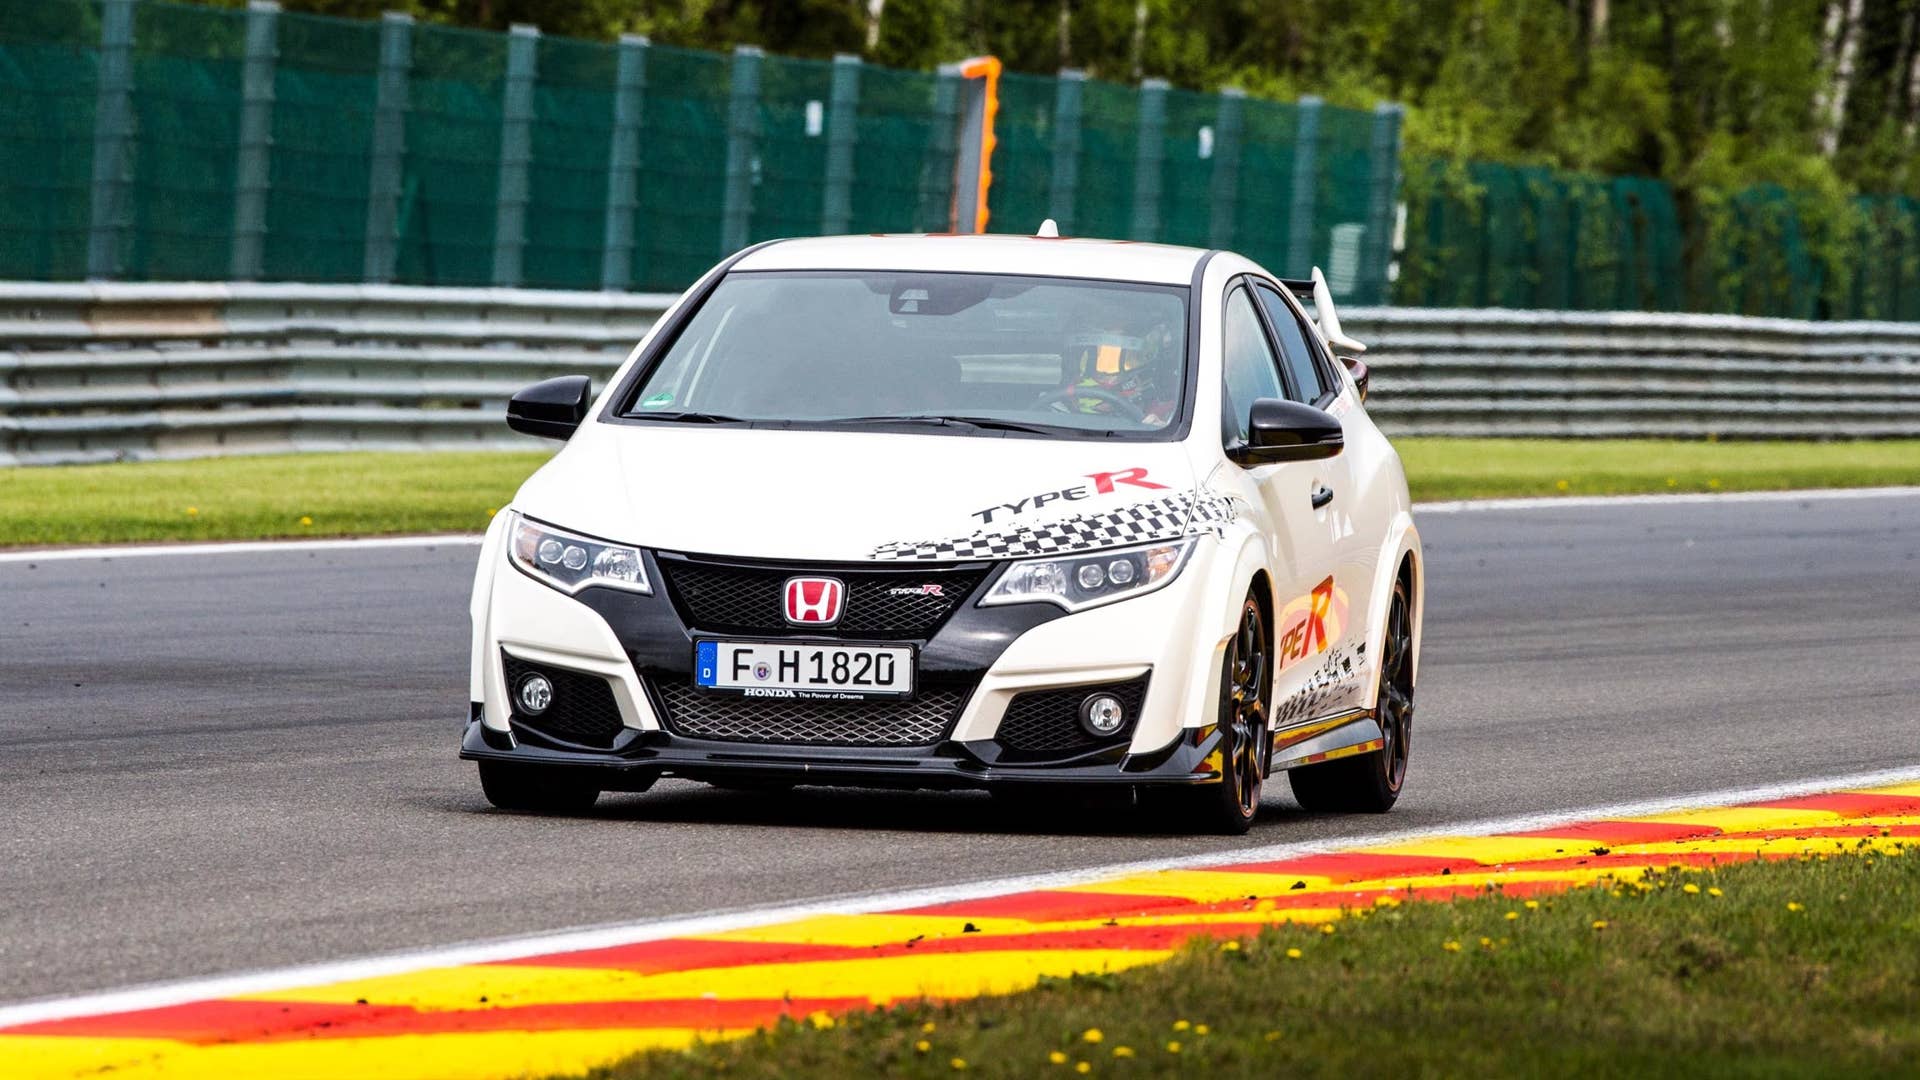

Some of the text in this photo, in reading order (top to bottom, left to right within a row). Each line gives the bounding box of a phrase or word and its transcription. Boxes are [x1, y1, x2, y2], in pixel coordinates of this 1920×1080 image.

[971, 467, 1172, 524] TYPE R
[1301, 574, 1334, 659] R
[702, 667, 711, 678] D
[732, 648, 754, 681] F
[744, 688, 796, 698] HONDA
